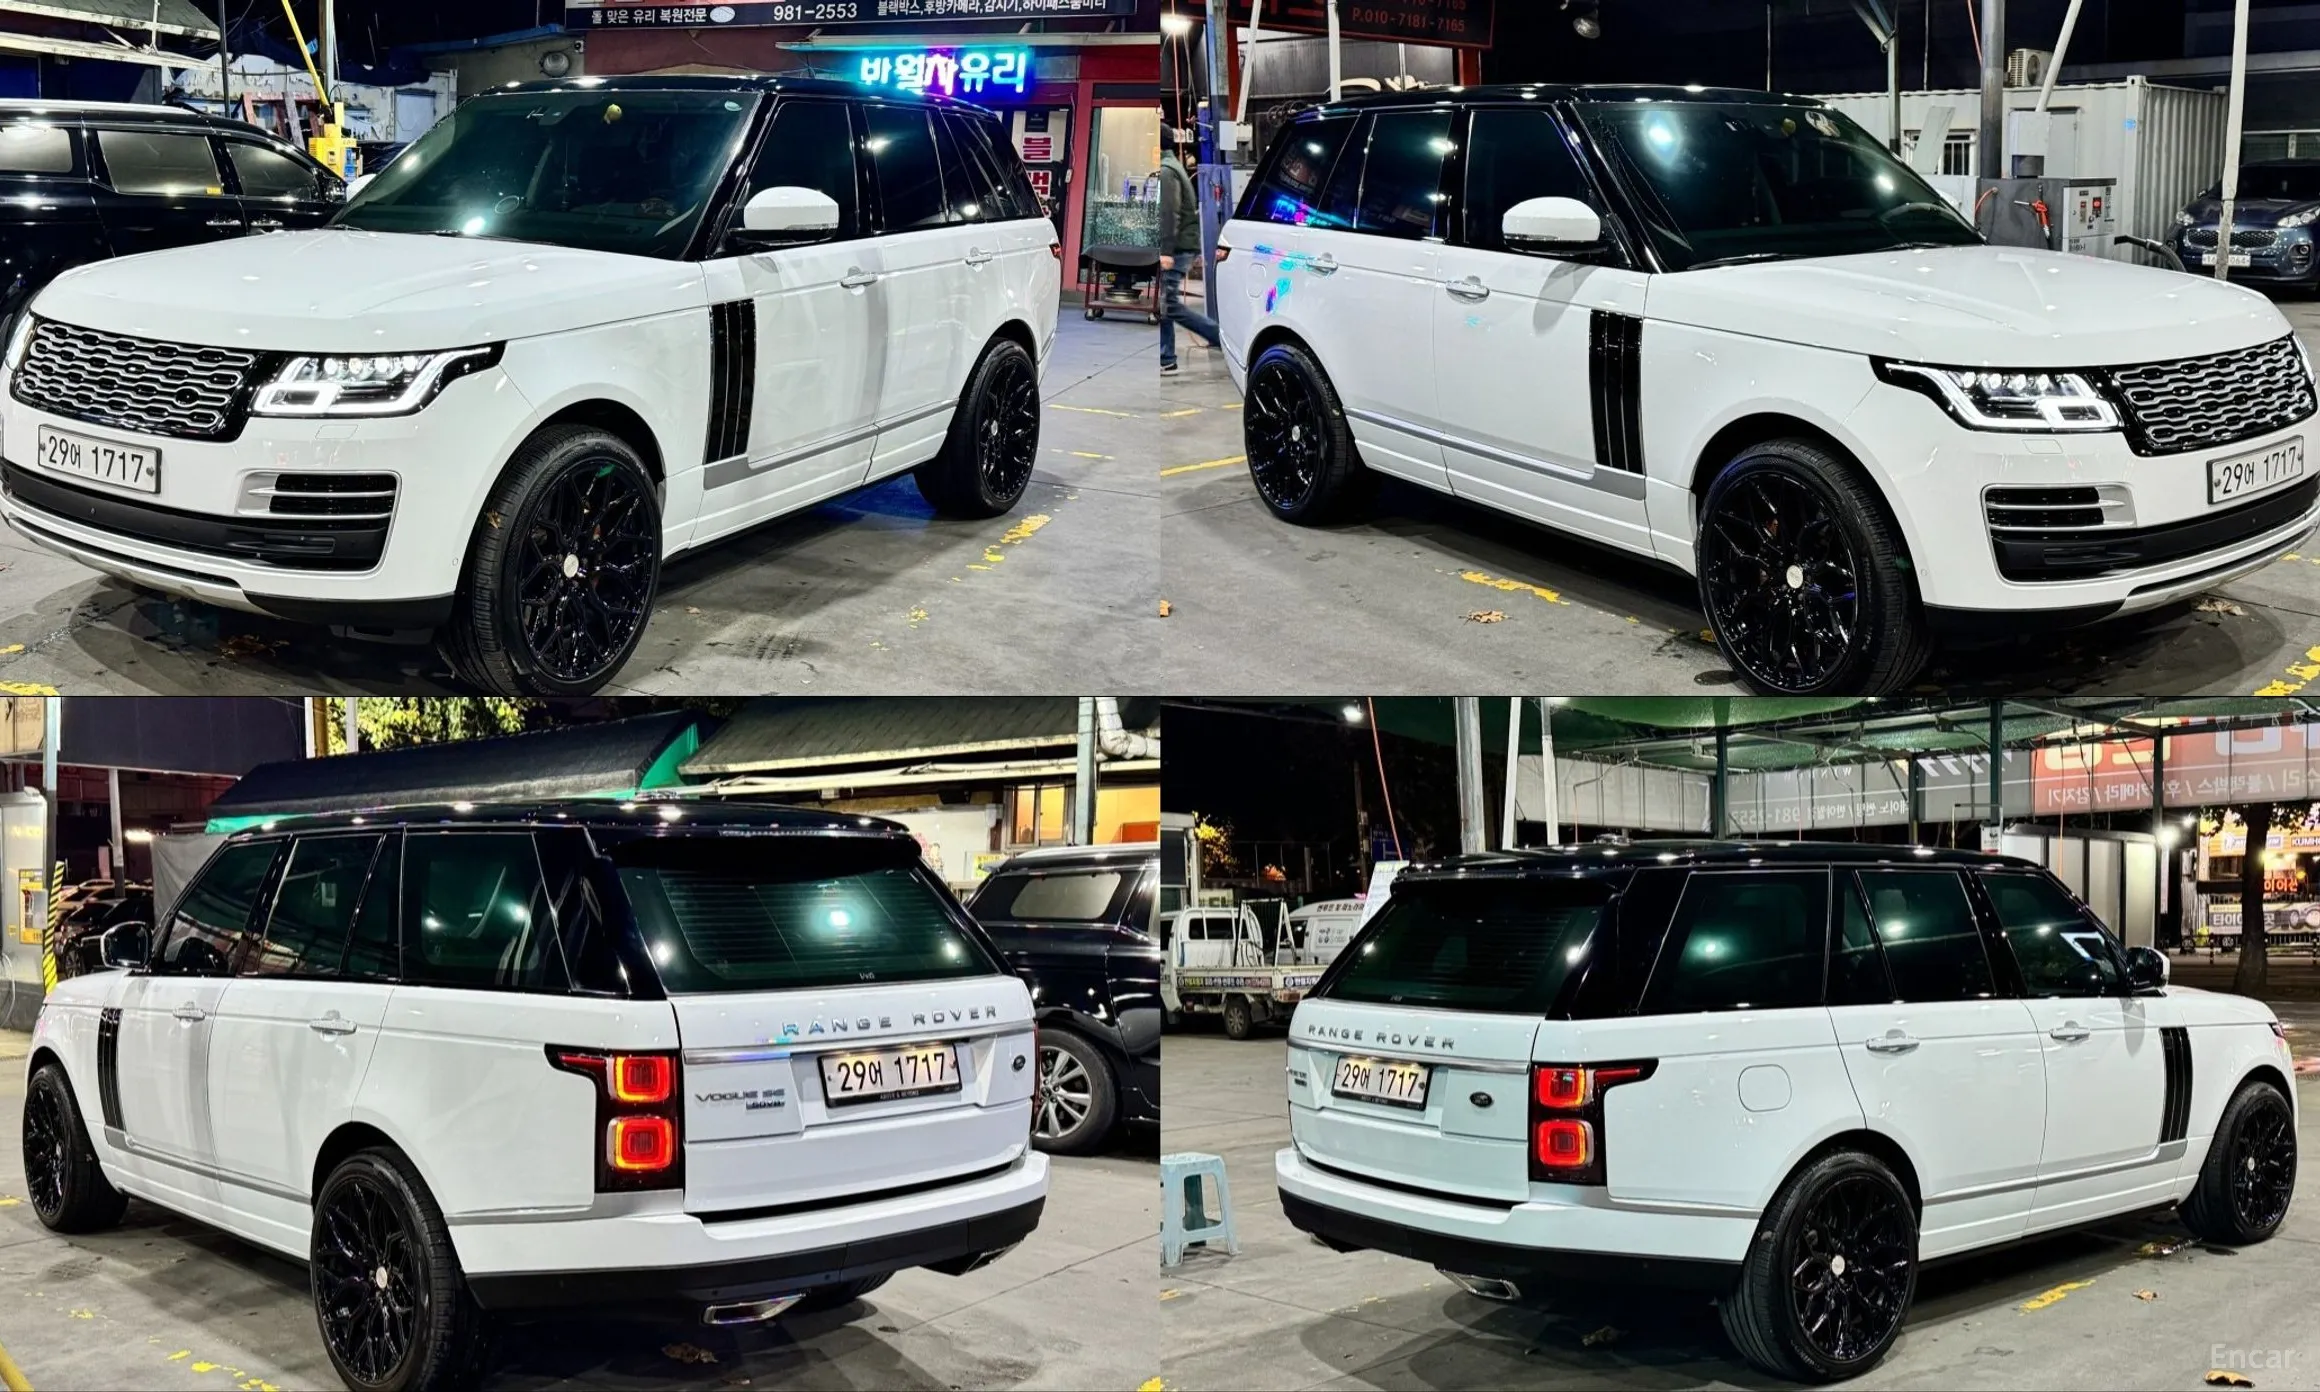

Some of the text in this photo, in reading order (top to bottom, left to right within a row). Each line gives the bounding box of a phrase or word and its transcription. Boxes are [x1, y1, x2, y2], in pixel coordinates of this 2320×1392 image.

[592, 7, 708, 24] 돌 맞은 유리 복원전문
[773, 2, 858, 21] 981-2553
[48, 435, 144, 483] 29어 1717
[2222, 445, 2297, 495] 29어 1717
[782, 1005, 998, 1036] RANGE ROVER
[1308, 1024, 1456, 1051] RANGE ROVER
[837, 1052, 946, 1092] 29어 1717
[1341, 1063, 1371, 1092] 29어
[1378, 1067, 1419, 1098] 1717
[695, 1090, 758, 1102] VOGUE
